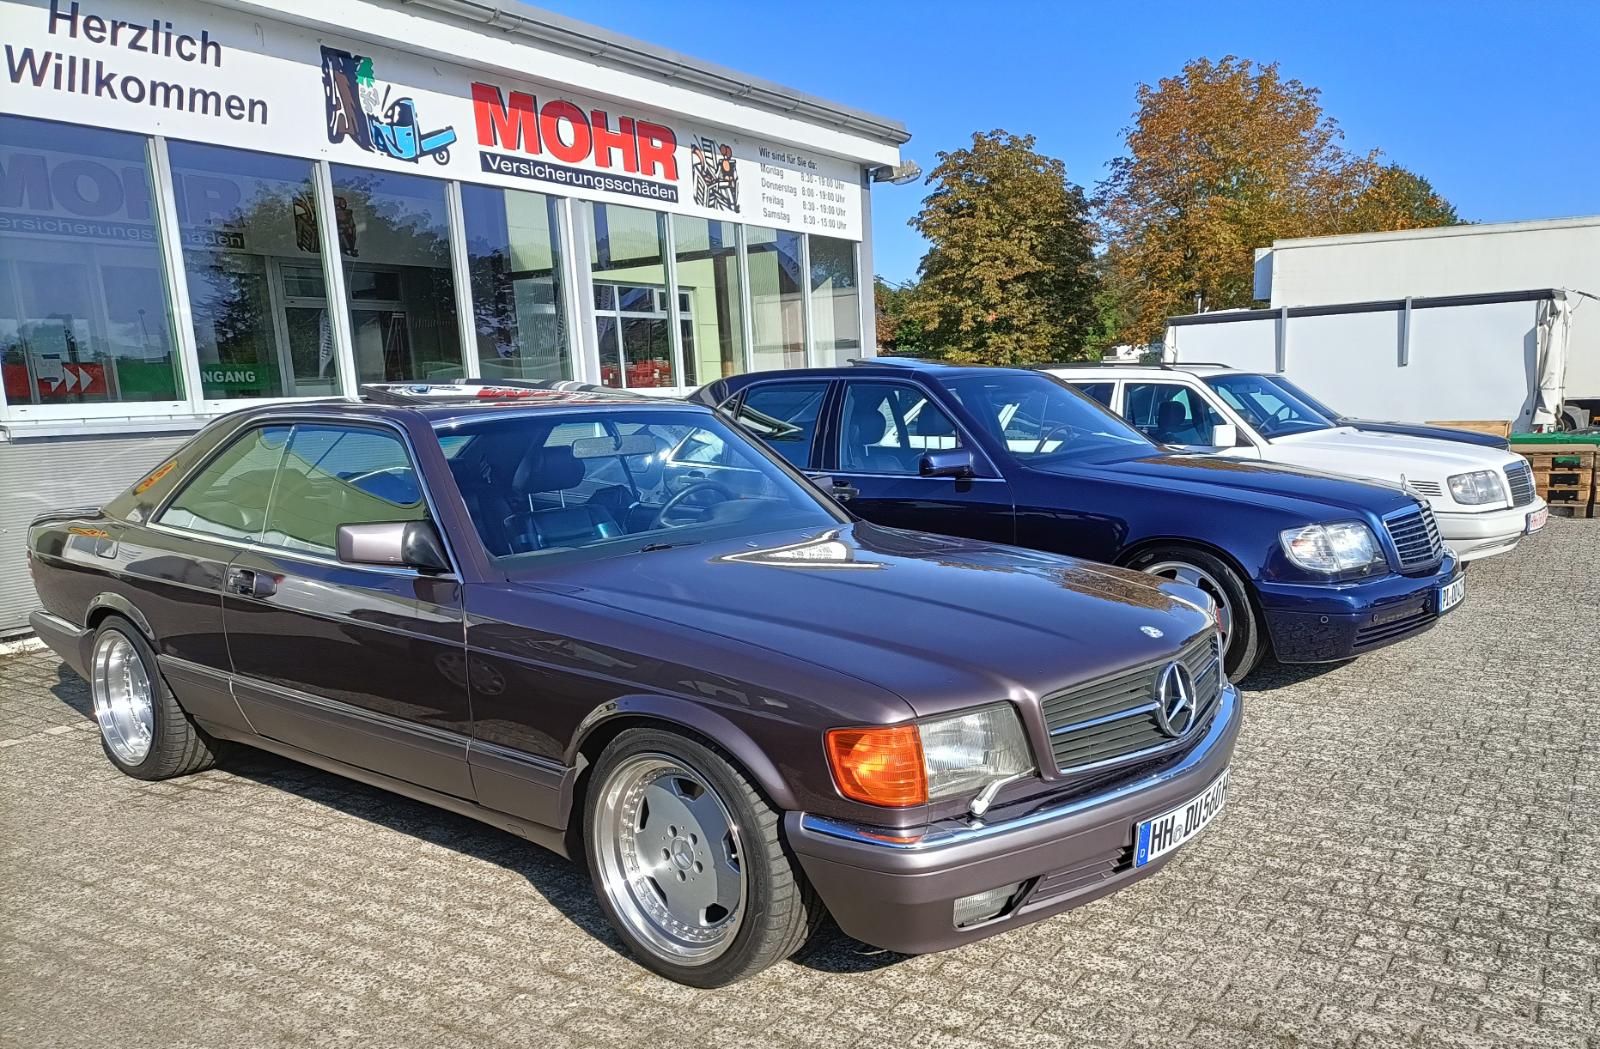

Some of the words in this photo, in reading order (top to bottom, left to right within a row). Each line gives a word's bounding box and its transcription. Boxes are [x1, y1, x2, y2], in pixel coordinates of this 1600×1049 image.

[48, 1, 222, 68] Herzlich
[4, 44, 268, 125] Willkommen
[471, 81, 680, 182] MOHR
[758, 146, 770, 158] Wir
[771, 151, 786, 162] sind
[786, 154, 796, 164] für
[797, 156, 807, 167] Sie
[485, 153, 678, 201] Versicherungsschäden
[760, 163, 784, 180] Montag
[761, 177, 798, 197] Donnerstag
[834, 180, 845, 190] Uhr
[762, 193, 784, 208] Freitag
[835, 193, 846, 203] Uhr
[762, 208, 790, 223] Samstag
[836, 207, 846, 217] Uhr
[836, 220, 847, 230] Uhr
[1150, 815, 1176, 855] HH
